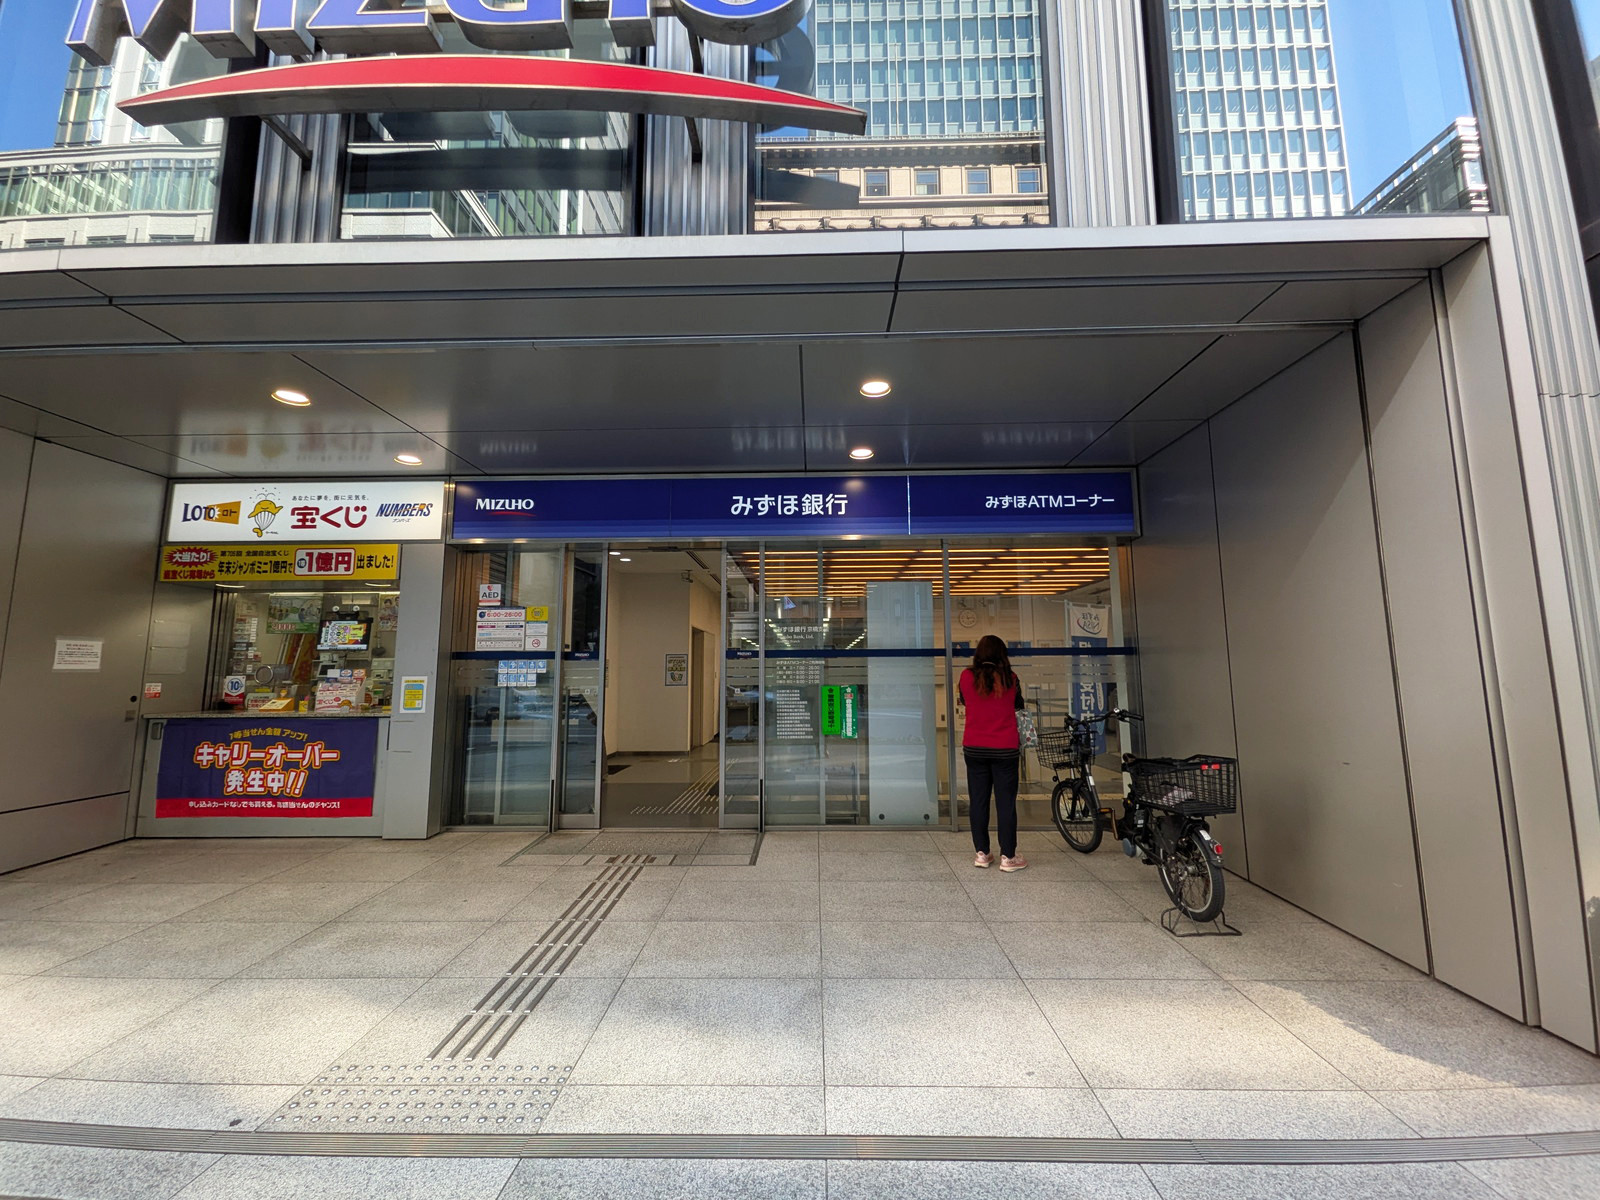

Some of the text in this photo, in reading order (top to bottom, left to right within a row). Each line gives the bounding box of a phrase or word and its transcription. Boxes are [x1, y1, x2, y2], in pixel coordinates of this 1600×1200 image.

[475, 498, 534, 510] MIZUHO
[730, 493, 848, 516] みずほ銀行
[985, 494, 1115, 509] みずほATMコーナー
[181, 502, 216, 522] LOTO
[222, 508, 237, 517] ロト
[290, 505, 367, 529] 宝くじ
[375, 503, 433, 517] NUMBERS
[172, 551, 210, 562] 大当たり!
[305, 551, 353, 573] 1億円
[356, 555, 394, 569] 出ました!
[481, 591, 499, 599] AED
[229, 727, 308, 741] 1等当せん金額 アップ!
[195, 742, 339, 768] キャリーオーバー
[225, 769, 307, 796] 発生中!!
